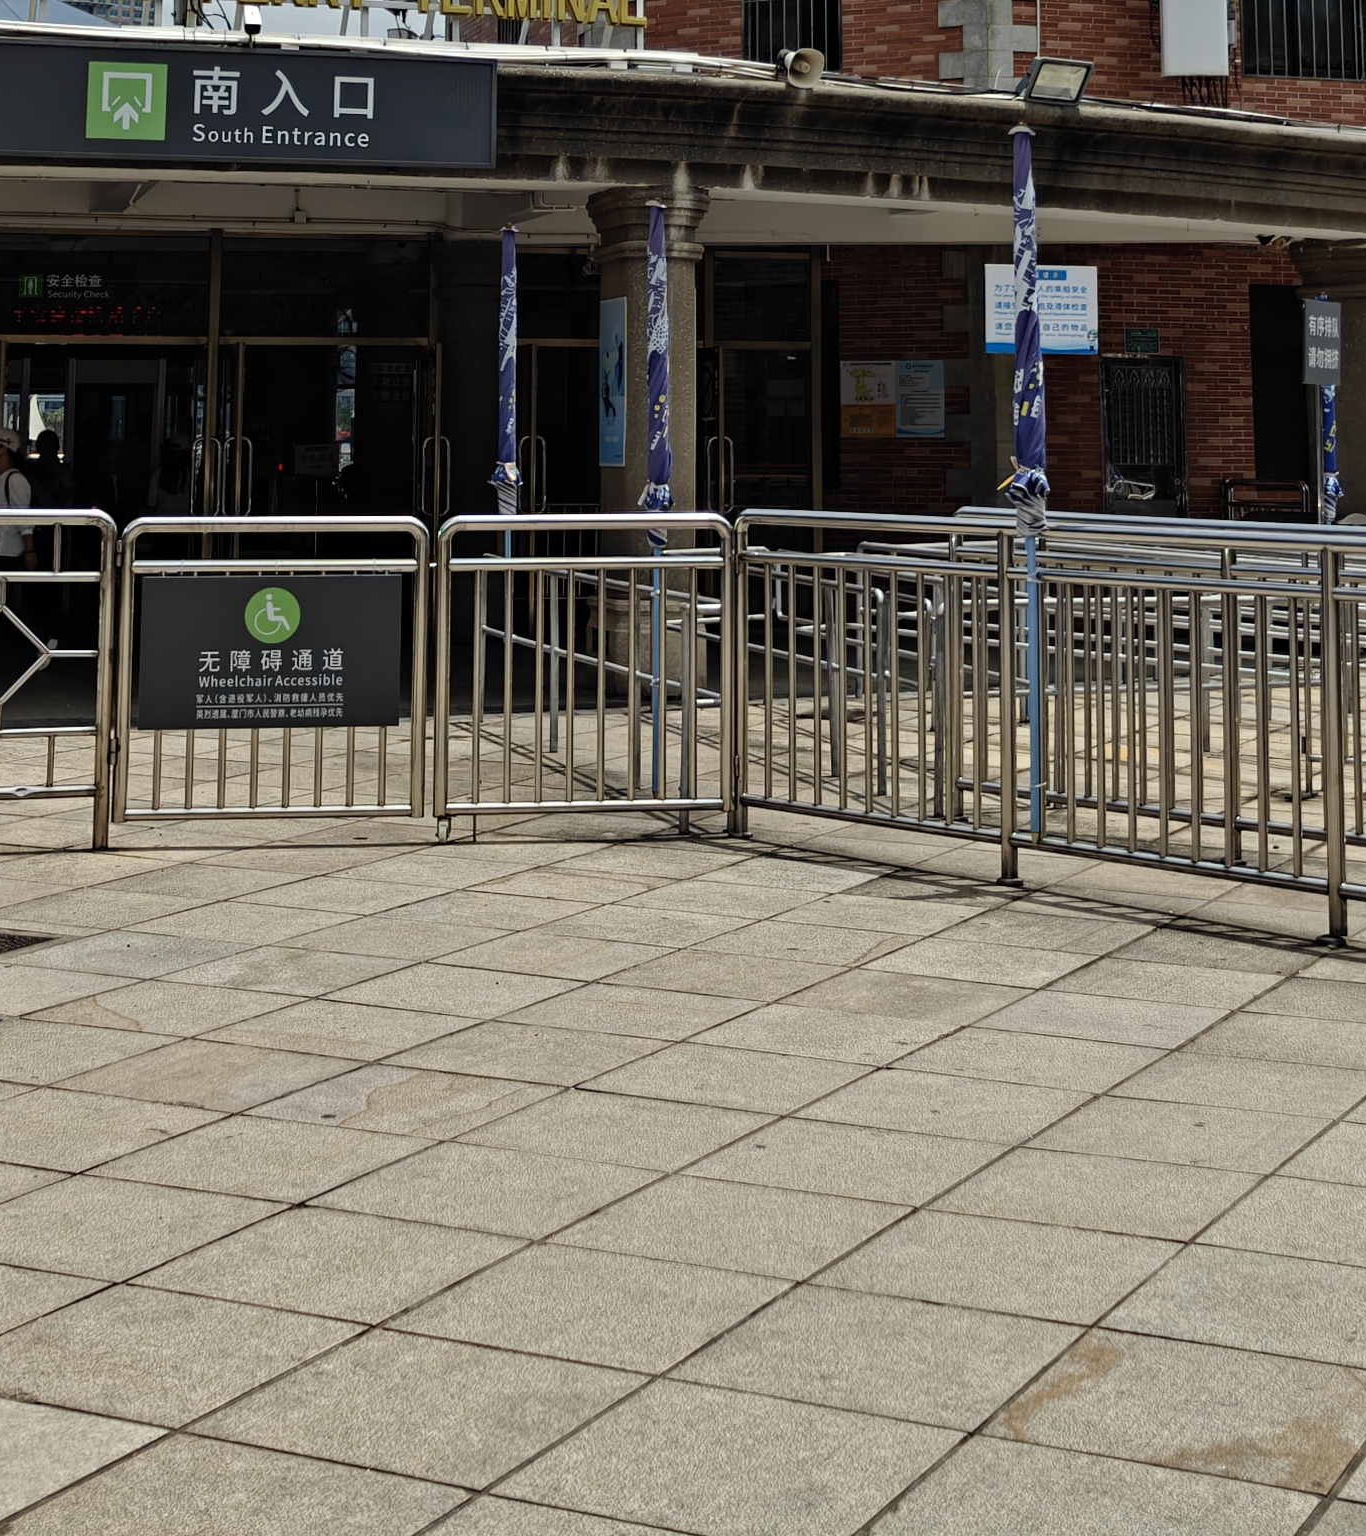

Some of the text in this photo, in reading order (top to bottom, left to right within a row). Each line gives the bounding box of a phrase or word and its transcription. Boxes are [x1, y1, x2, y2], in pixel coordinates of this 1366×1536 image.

[192, 66, 375, 119] 南入口
[192, 122, 370, 148] South Entrance
[46, 274, 103, 288] 安全检查
[47, 290, 110, 300] Security Check
[1308, 314, 1339, 338] 有序排队
[1308, 347, 1340, 369] 请勿拥挤
[199, 648, 344, 672] 无障碍通道
[199, 673, 343, 688] Wheelchair Accessible
